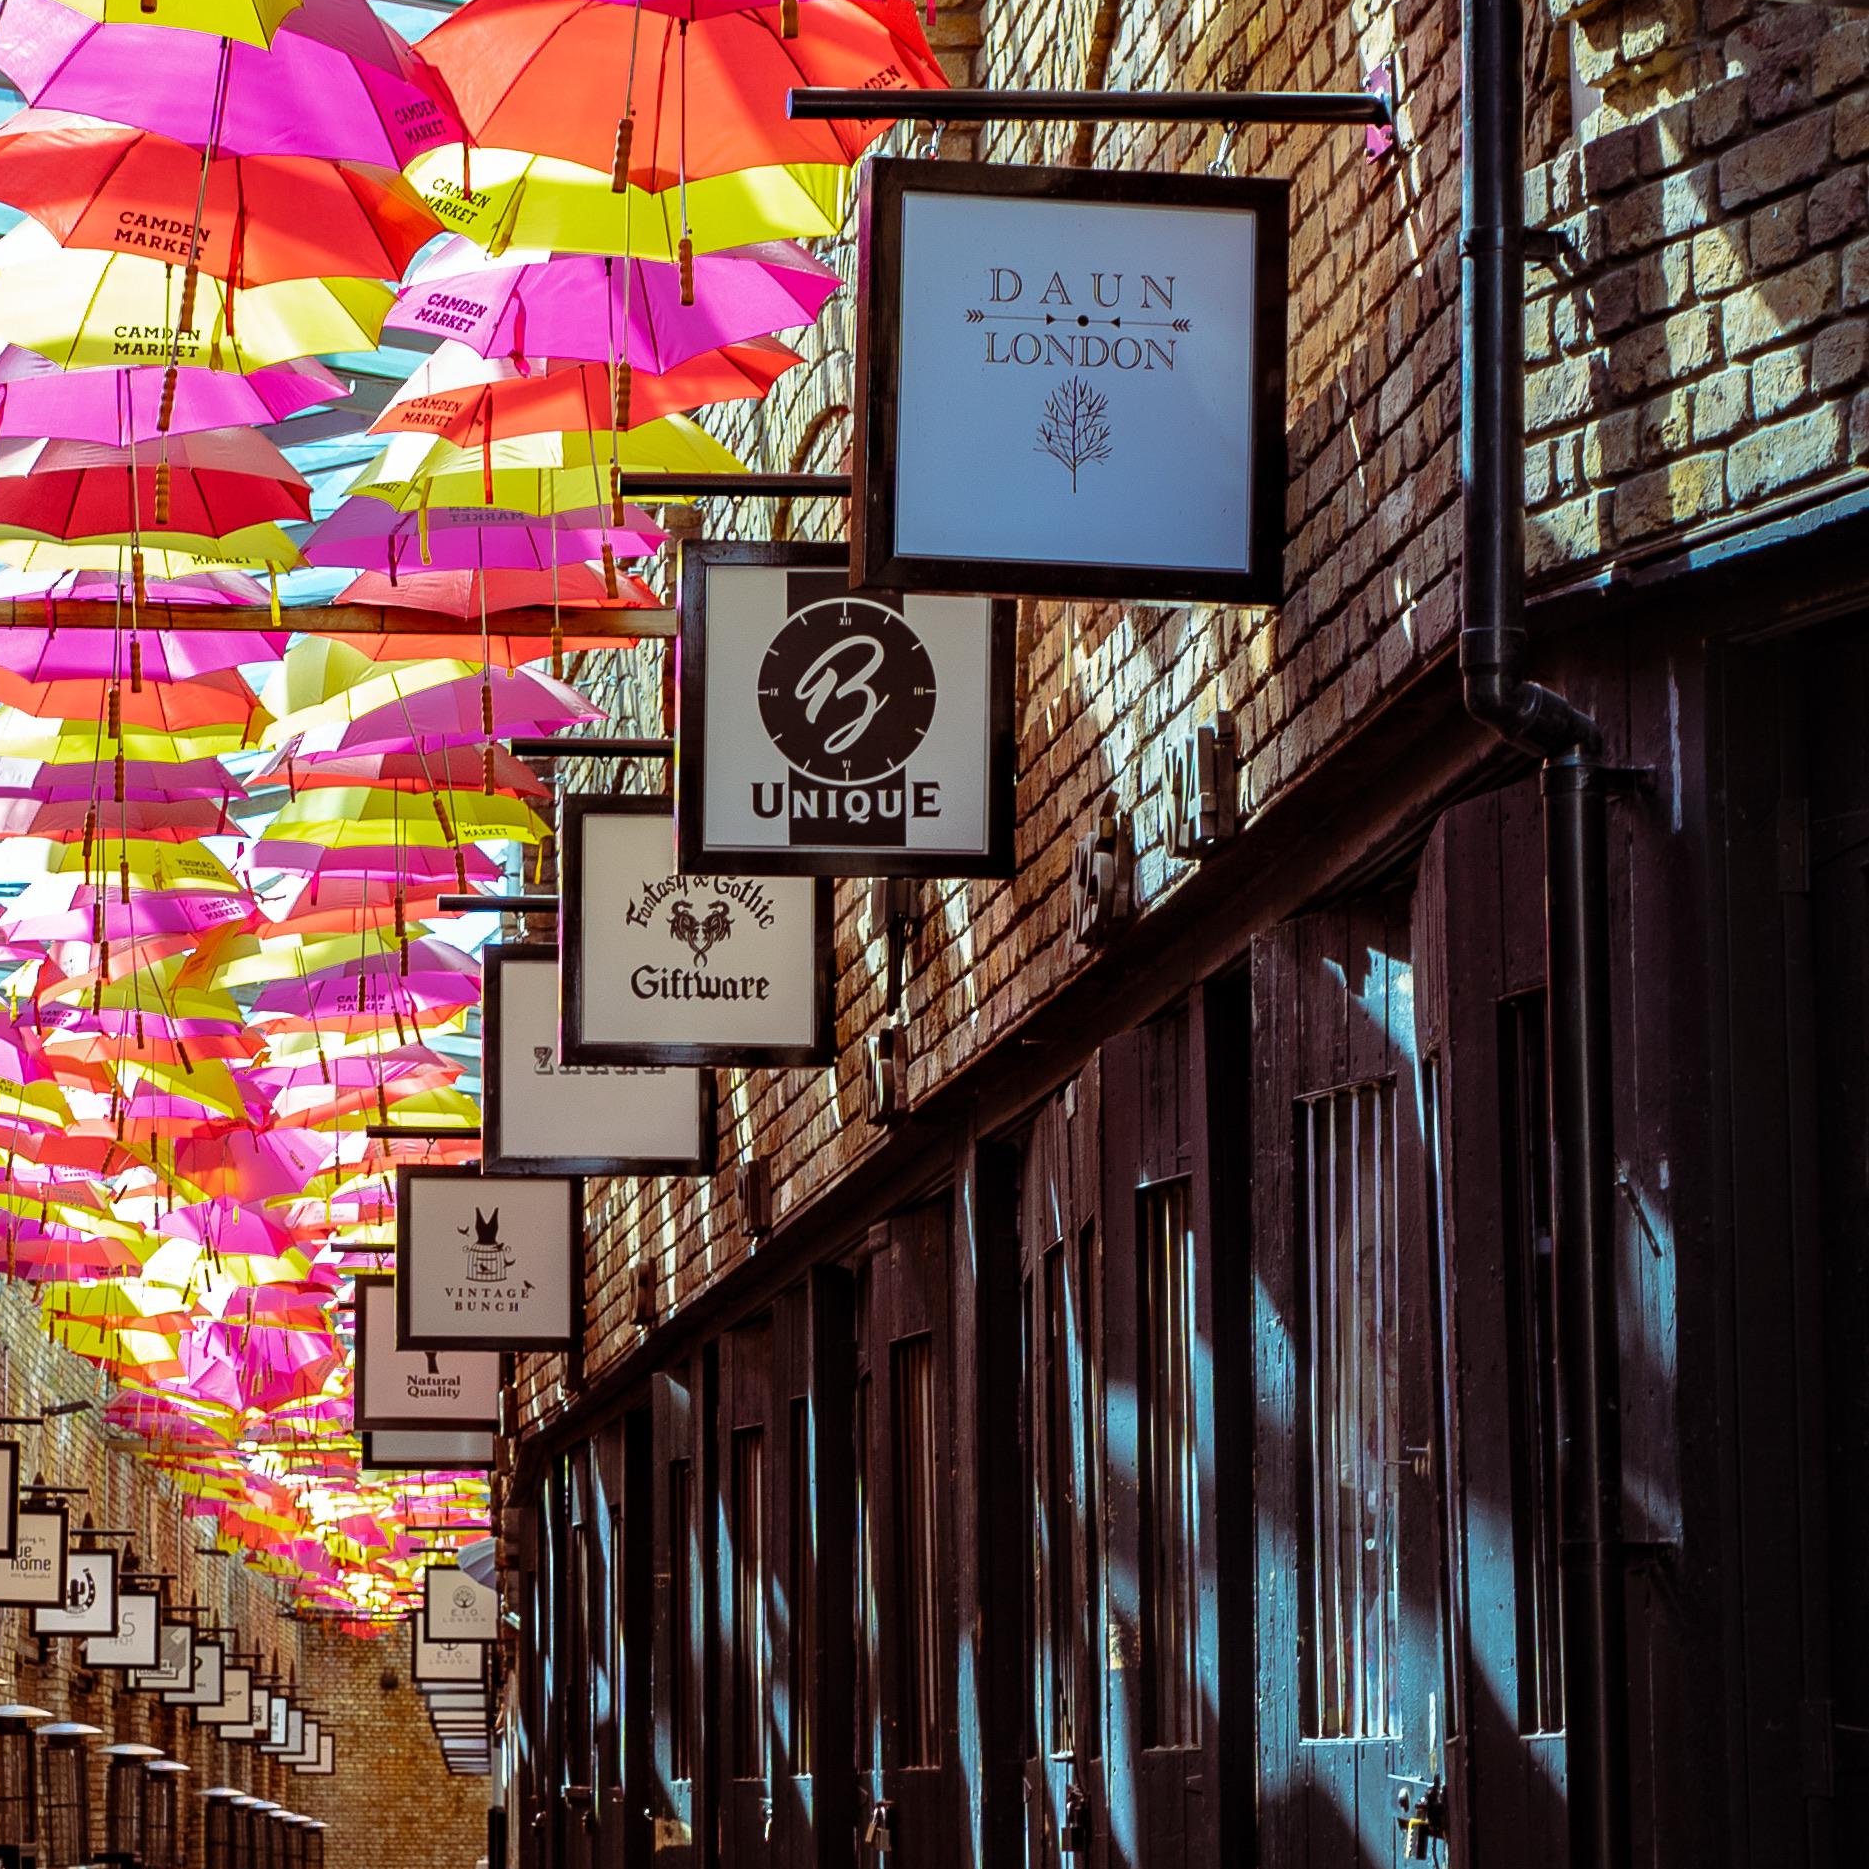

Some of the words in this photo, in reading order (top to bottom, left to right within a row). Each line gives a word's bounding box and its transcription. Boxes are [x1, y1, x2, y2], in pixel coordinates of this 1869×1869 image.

[394, 99, 438, 125] CAMDEN
[405, 119, 447, 145] MARKET
[432, 178, 491, 209] CAMEN
[119, 211, 211, 242] CAMDEN
[114, 228, 205, 261] MARKET
[988, 268, 1176, 310] DAUN
[427, 293, 488, 319] CAMDEN
[415, 306, 476, 334] MARKET
[984, 331, 1176, 371] LONDON
[410, 396, 462, 414] CAMDEN
[401, 411, 453, 429] MARKET
[795, 635, 890, 754] B
[750, 781, 942, 824] UNIQUE
[463, 827, 508, 838] MARKET
[626, 875, 690, 929] Fantasy
[713, 875, 775, 930] Gothic
[631, 964, 771, 1002] Giftware
[445, 1287, 530, 1300] VINTAGE
[454, 1301, 520, 1313] BUNCH
[406, 1374, 461, 1387] Natural
[407, 1386, 461, 1400] Quality
